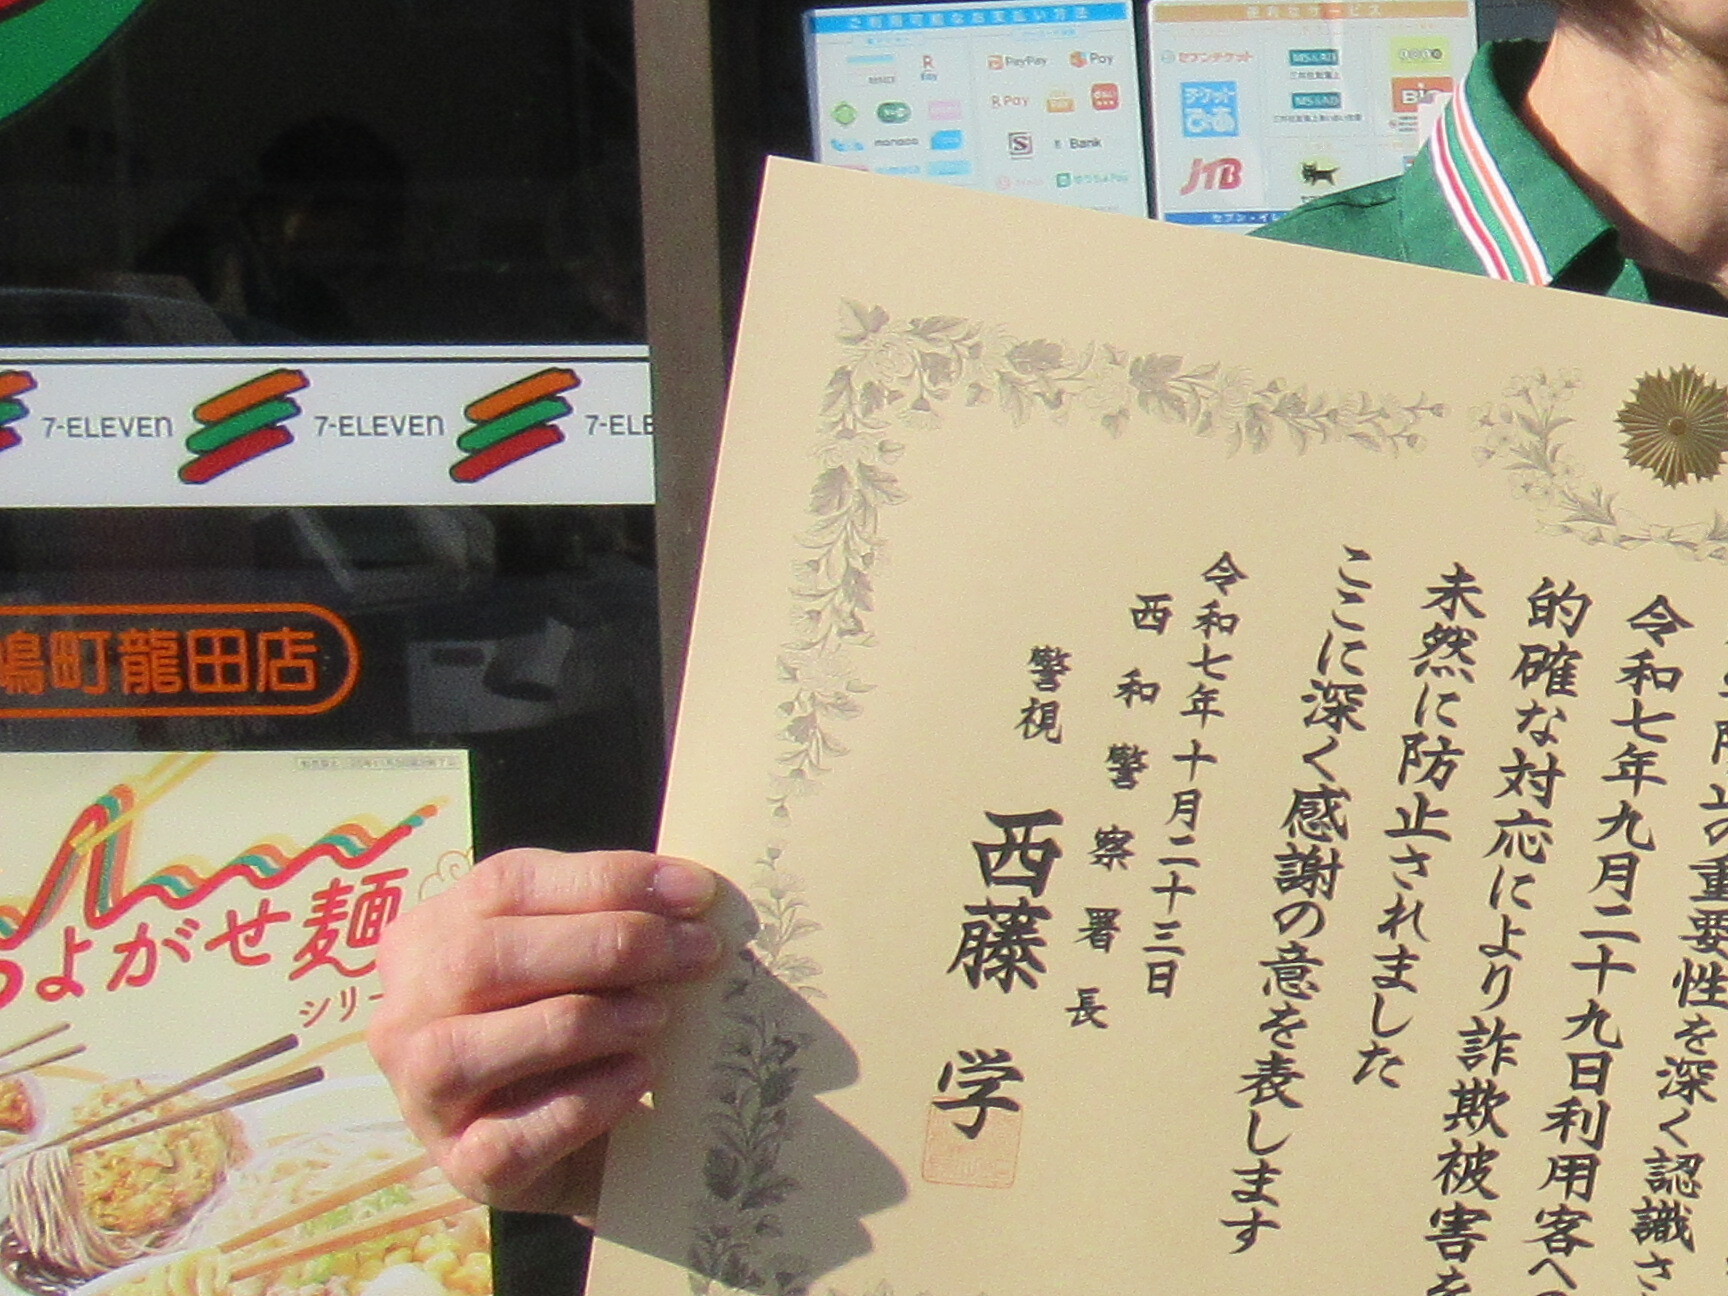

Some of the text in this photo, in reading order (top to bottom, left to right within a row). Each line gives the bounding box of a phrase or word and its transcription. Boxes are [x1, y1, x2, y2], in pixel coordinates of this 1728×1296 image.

[1005, 55, 1048, 68] PayPay
[1184, 86, 1238, 103] チケット
[1184, 107, 1237, 134] ぴあ
[1180, 157, 1246, 196] JTB
[1015, 644, 1073, 745] 警視
[1065, 592, 1175, 1030] 西和警察署長
[1142, 551, 1249, 1000] 令和七年十月二十三日
[1352, 562, 1487, 1090] 未然に防止されました
[946, 807, 1065, 994] 西藤
[1219, 545, 1375, 1254] ここに深く感謝の意を表します
[931, 1047, 1025, 1141] 学
